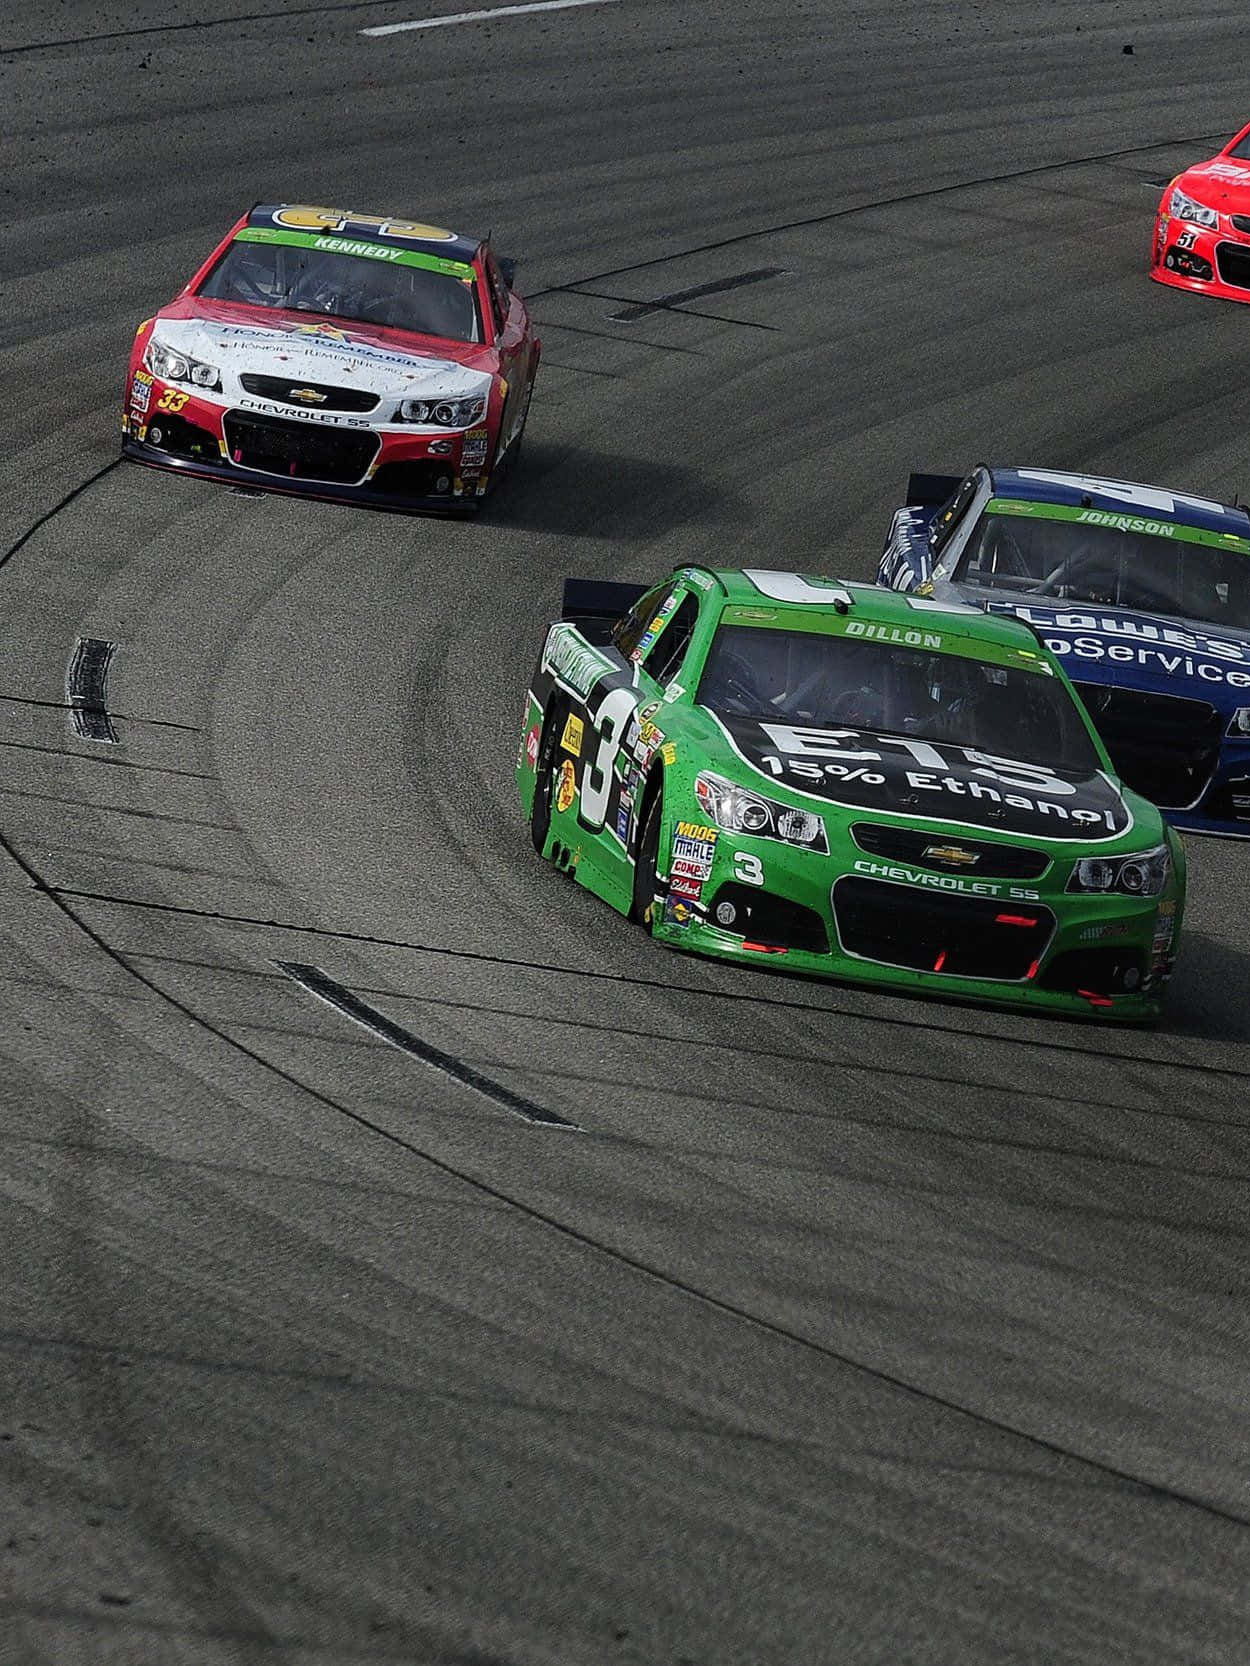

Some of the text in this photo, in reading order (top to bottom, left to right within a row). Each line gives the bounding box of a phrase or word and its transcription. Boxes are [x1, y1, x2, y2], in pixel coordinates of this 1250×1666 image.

[314, 237, 404, 259] KENNEDY
[1177, 231, 1197, 249] 51
[157, 388, 190, 412] 33
[239, 399, 370, 428] CHEVROLET SS
[1076, 510, 1175, 537] JOHNSON
[845, 621, 942, 649] DILLON
[580, 688, 638, 827] 3
[758, 722, 1077, 794] E15
[761, 755, 1116, 832] 15% Ethanol
[676, 821, 720, 843] MOOG
[674, 839, 714, 861] MAHLE
[674, 860, 701, 876] COMP
[734, 851, 765, 887] 3
[853, 860, 1040, 900] CHEVROLET SS
